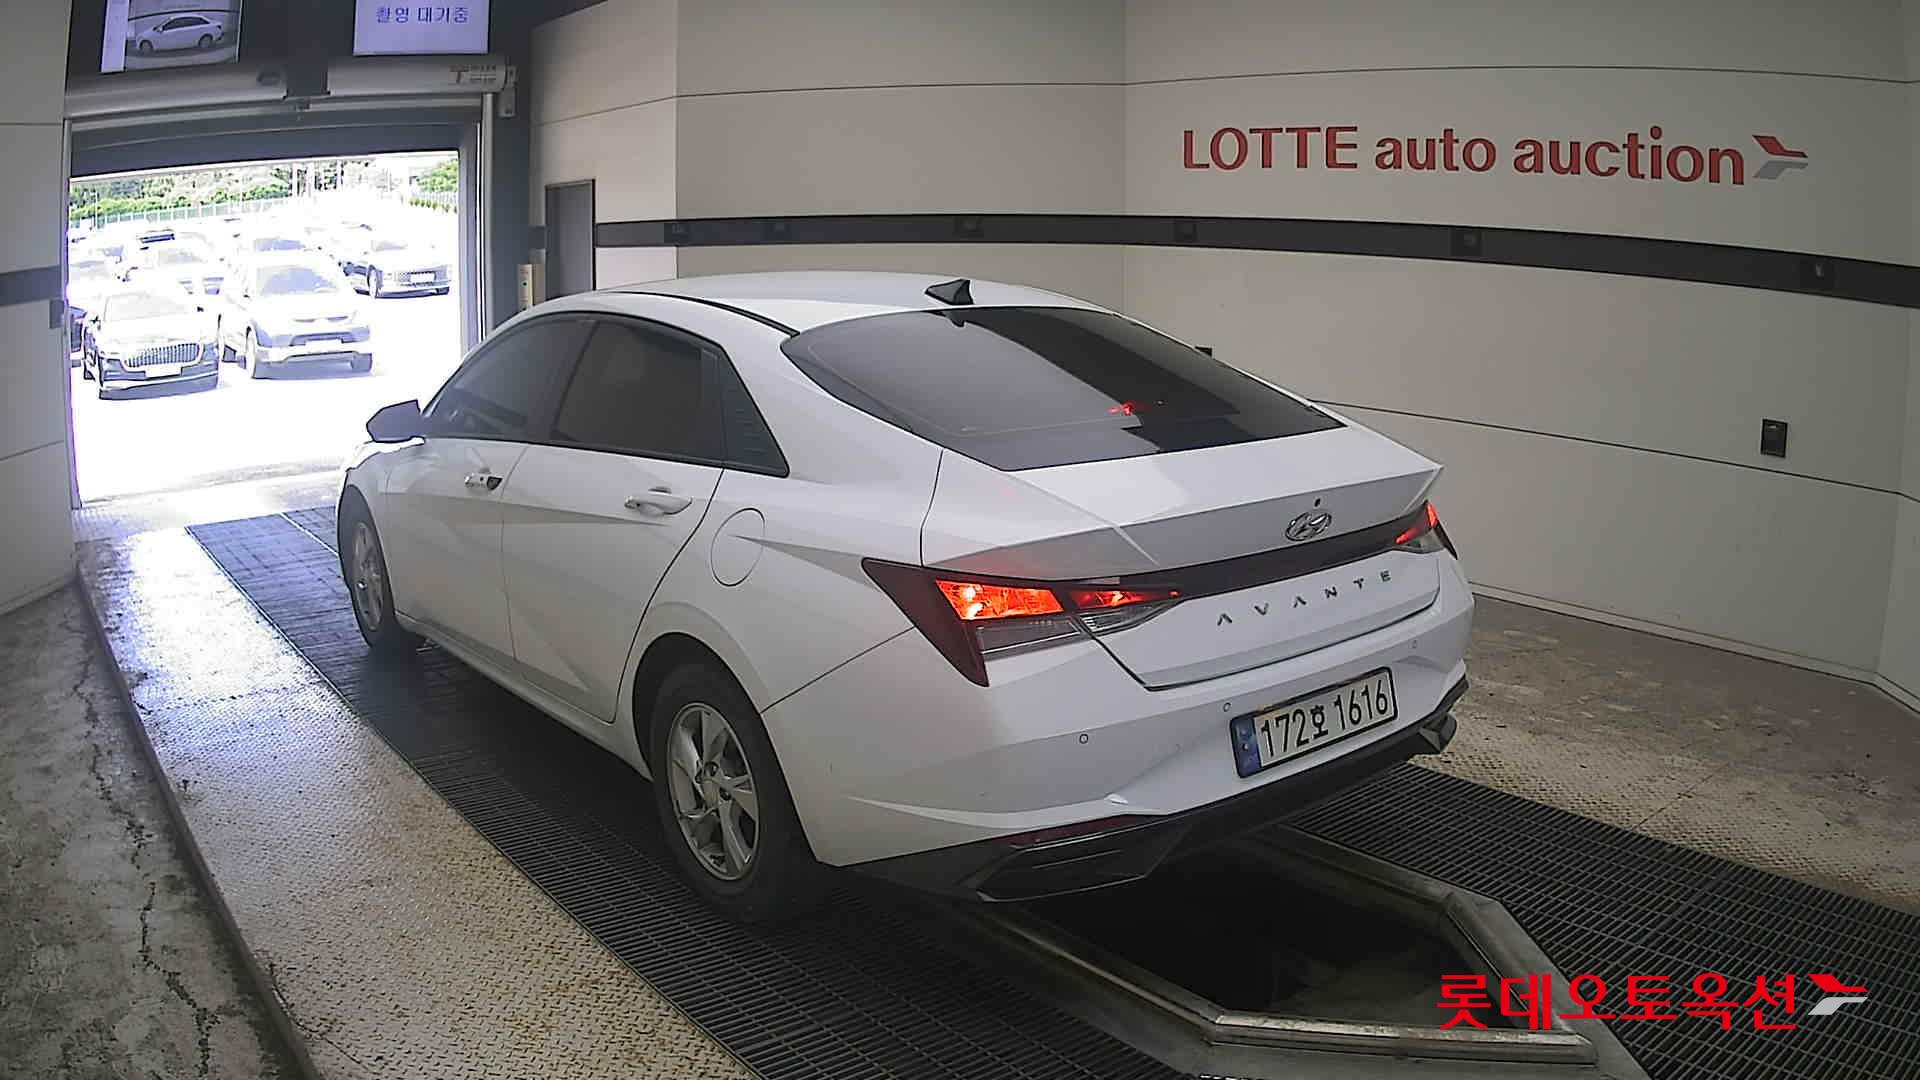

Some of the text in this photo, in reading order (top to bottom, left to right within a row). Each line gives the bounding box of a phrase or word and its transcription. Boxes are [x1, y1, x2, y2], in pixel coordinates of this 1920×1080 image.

[417, 6, 469, 24] 대기중
[1183, 126, 1745, 185] LOTTE auto auction
[1217, 570, 1392, 627] AVANTE
[1261, 679, 1388, 757] 172호 1616
